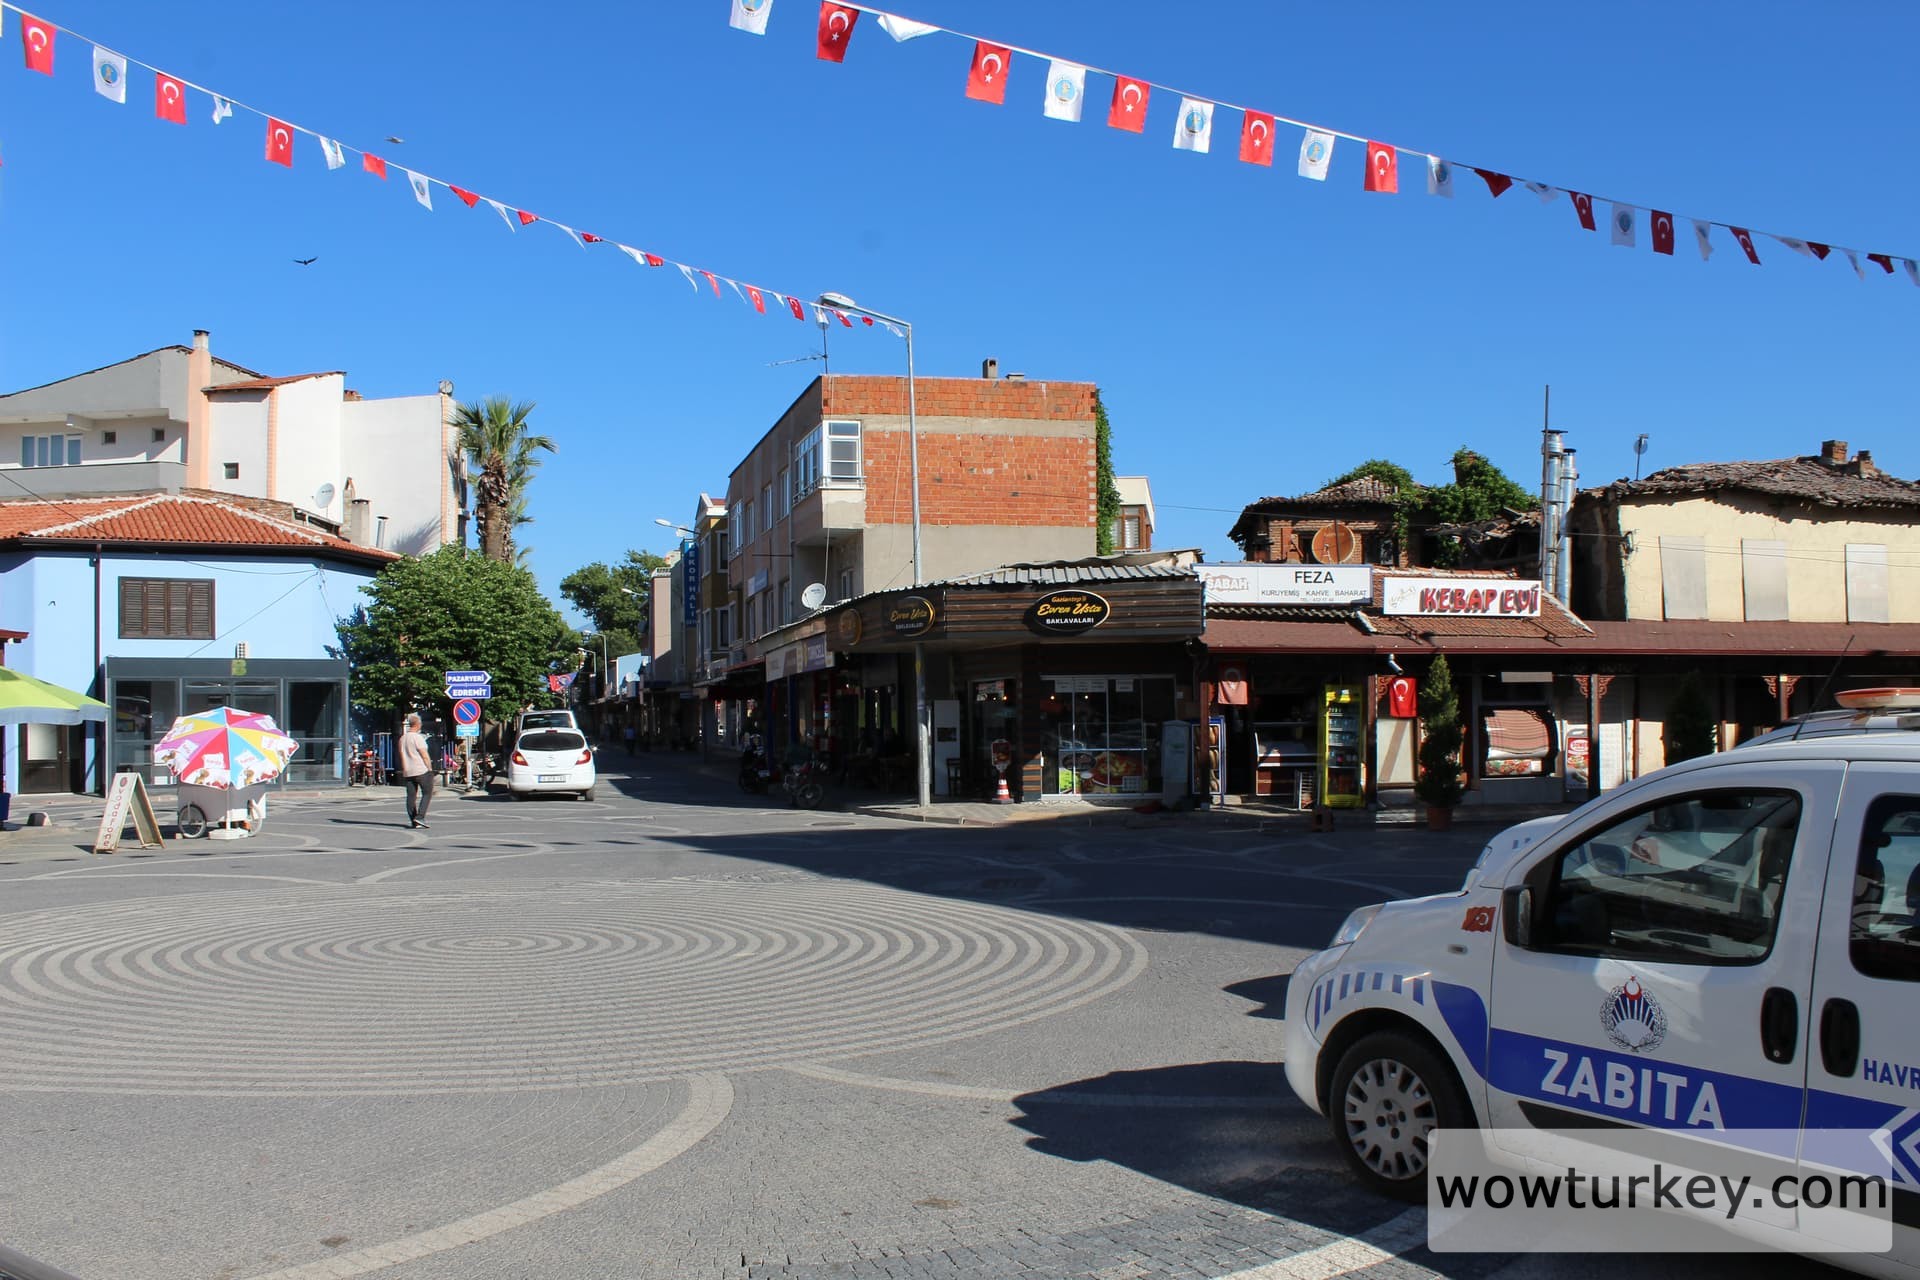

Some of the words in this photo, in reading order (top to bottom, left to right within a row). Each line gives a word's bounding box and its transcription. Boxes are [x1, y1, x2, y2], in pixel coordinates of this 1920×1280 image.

[1295, 571, 1335, 584] FEZA
[1261, 588, 1300, 597] KURUYEMİŞ
[1305, 589, 1330, 597] KAHVE
[1334, 589, 1368, 597] BAHARAT
[1419, 587, 1498, 613] KEBAP
[1037, 604, 1071, 616] Evren
[1072, 603, 1102, 615] Usta
[1046, 617, 1095, 625] BAKLAVALARI
[447, 674, 485, 683] PAZARYERİ
[452, 687, 488, 697] EDREMİT
[1540, 1048, 1726, 1132] ZABITA
